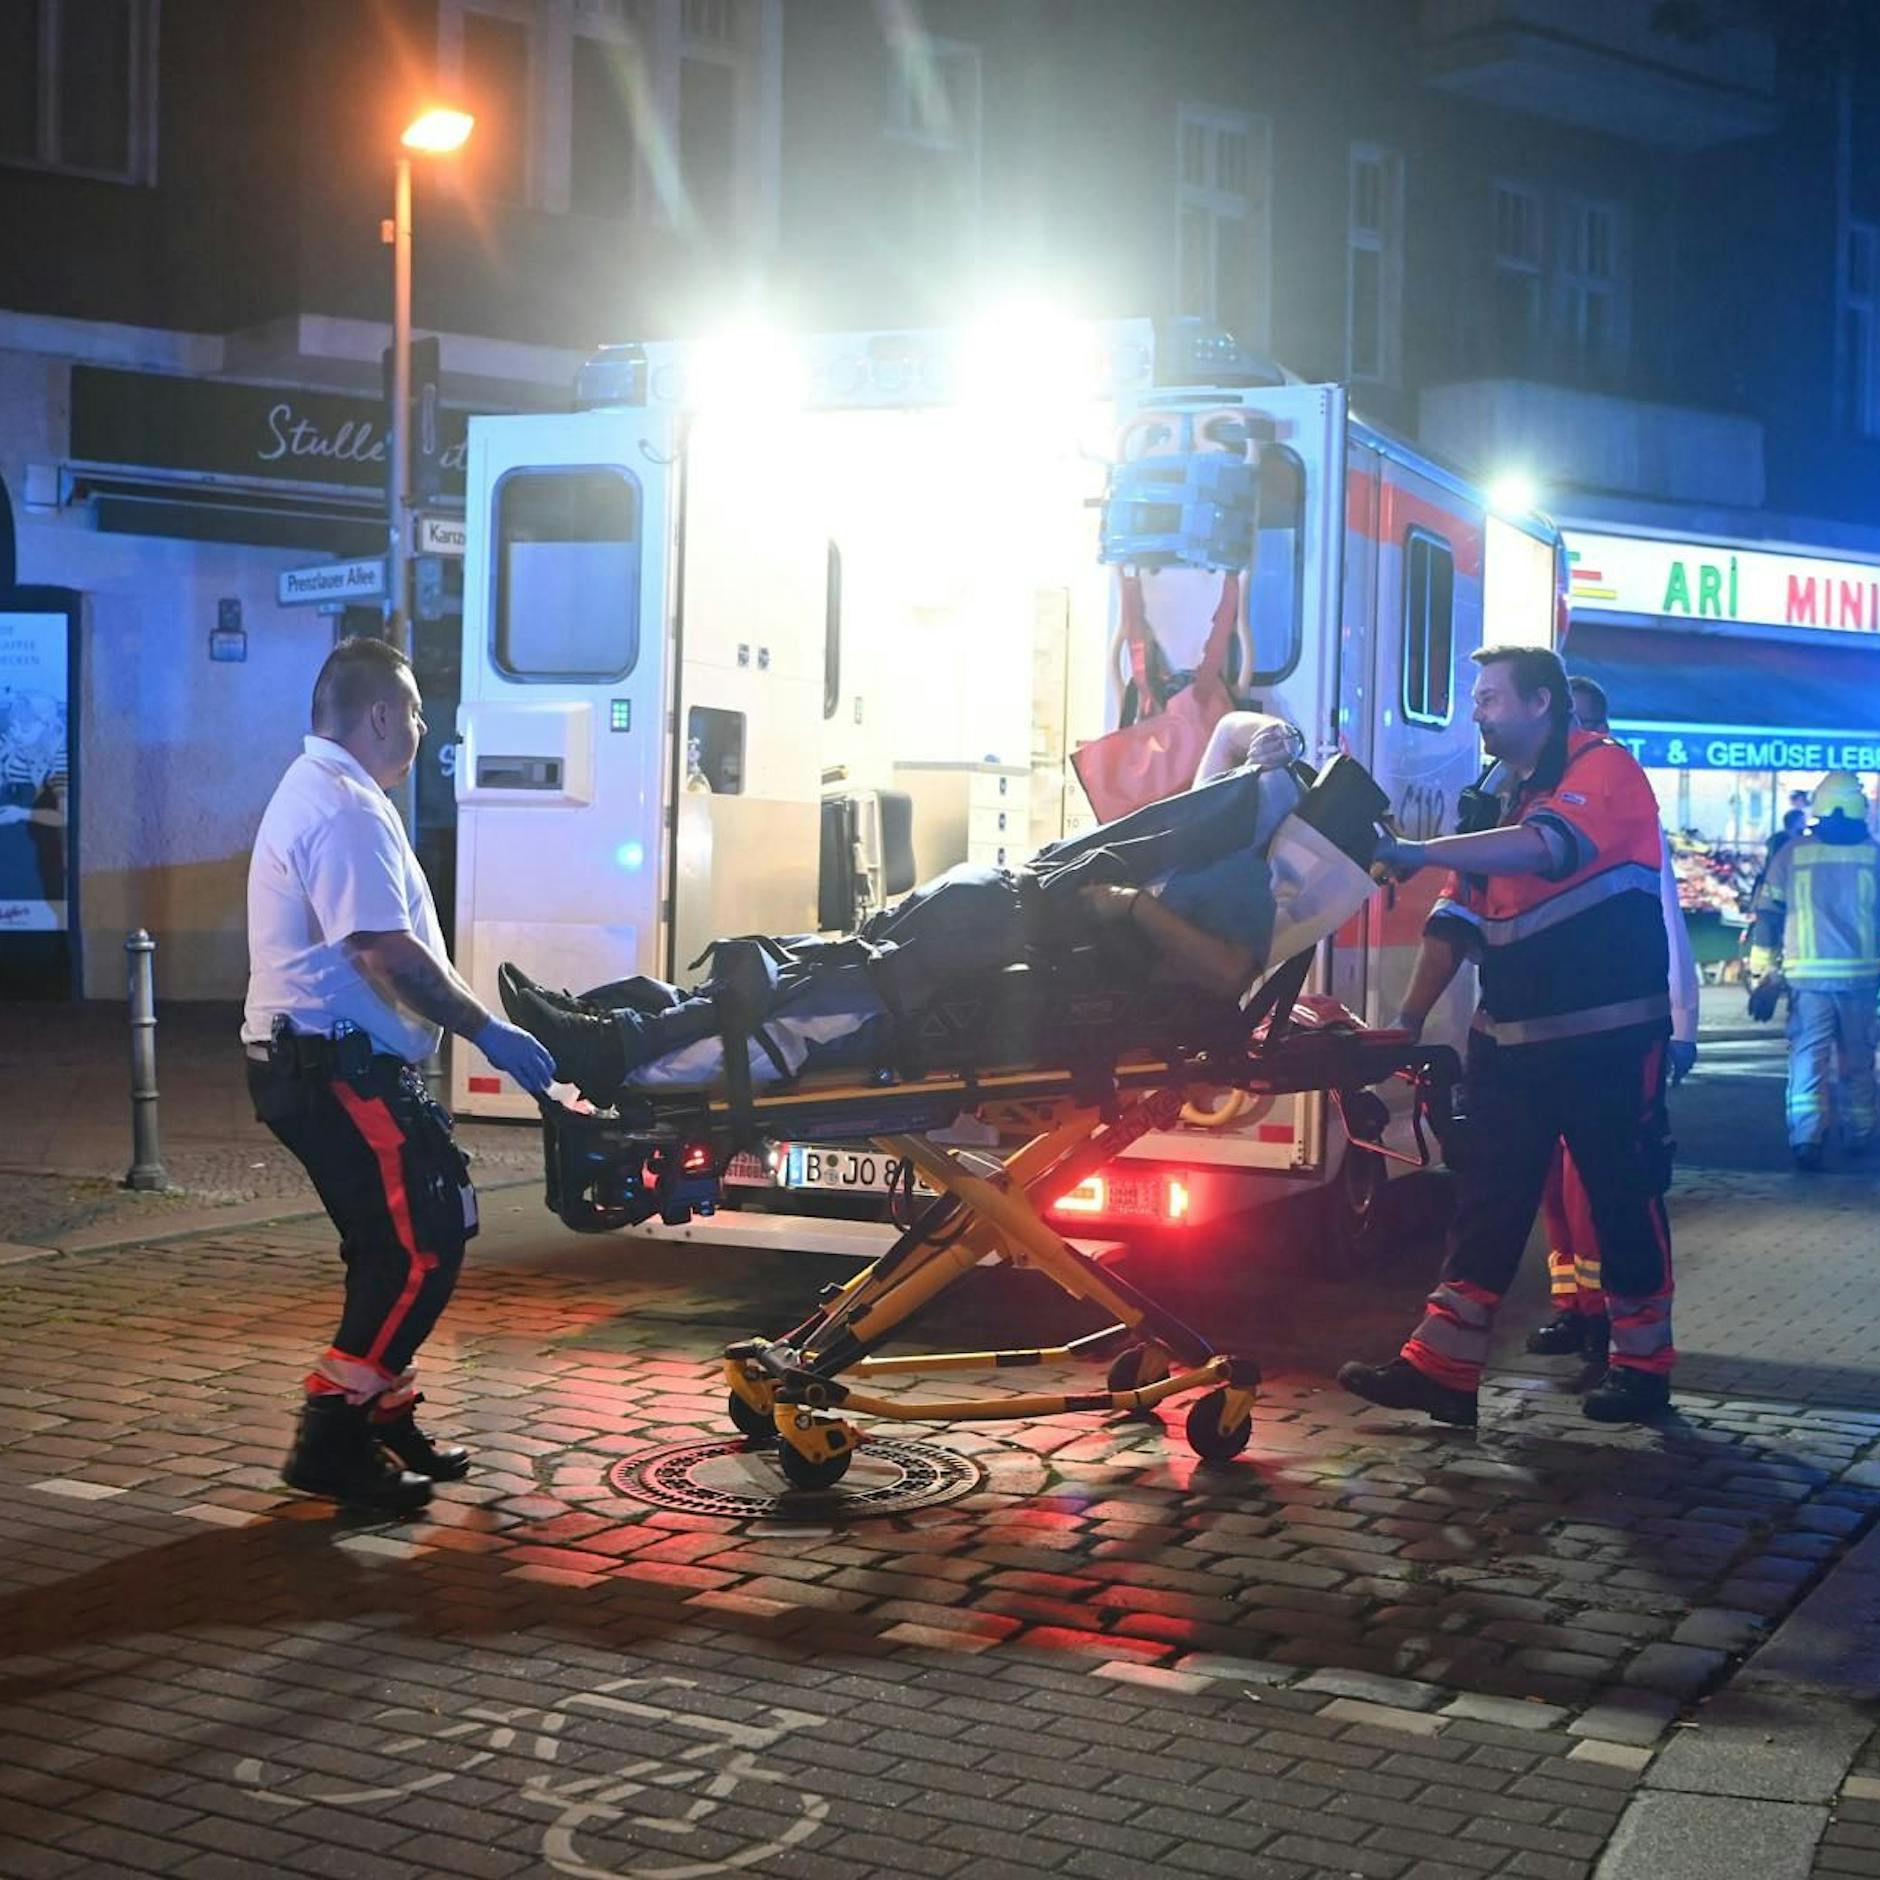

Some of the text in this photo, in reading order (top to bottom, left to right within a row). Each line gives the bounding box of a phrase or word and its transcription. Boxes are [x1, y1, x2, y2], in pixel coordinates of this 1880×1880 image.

[258, 404, 386, 461] Stulle
[286, 566, 376, 592] Prenzlauer Allee
[1786, 574, 1879, 630] MINI
[1667, 739, 1689, 765] &
[1706, 740, 1822, 769] GEMÜSE
[1827, 746, 1880, 770] LEB
[806, 1153, 821, 1183] B
[842, 1157, 876, 1186] JO
